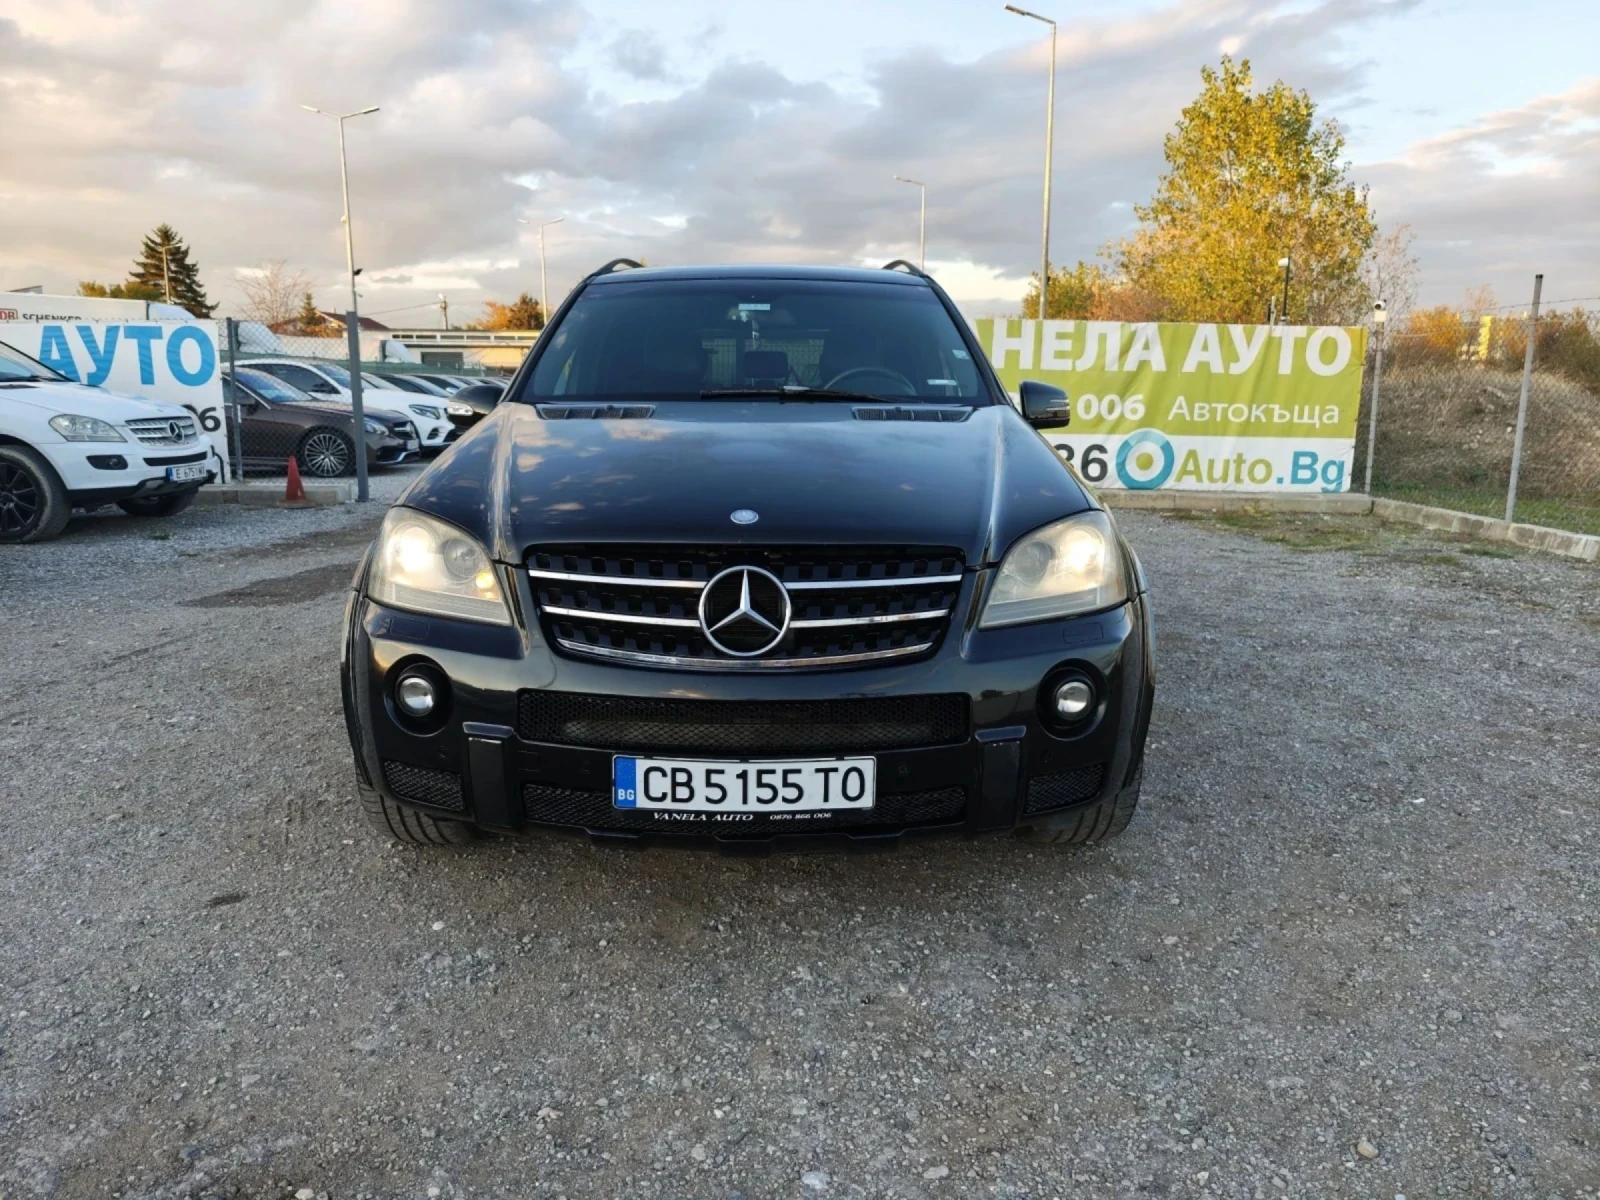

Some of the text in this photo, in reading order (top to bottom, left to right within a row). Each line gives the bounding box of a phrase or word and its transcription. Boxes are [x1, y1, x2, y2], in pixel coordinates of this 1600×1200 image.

[0, 310, 15, 320] DB
[38, 325, 215, 386] АУТО
[964, 318, 1352, 377] НЕЛА АУТО
[1077, 393, 1340, 429] 006 Автокъща
[618, 789, 635, 800] BG
[643, 766, 695, 803] CB
[705, 768, 804, 805] 5155
[653, 812, 707, 821] VANELA
